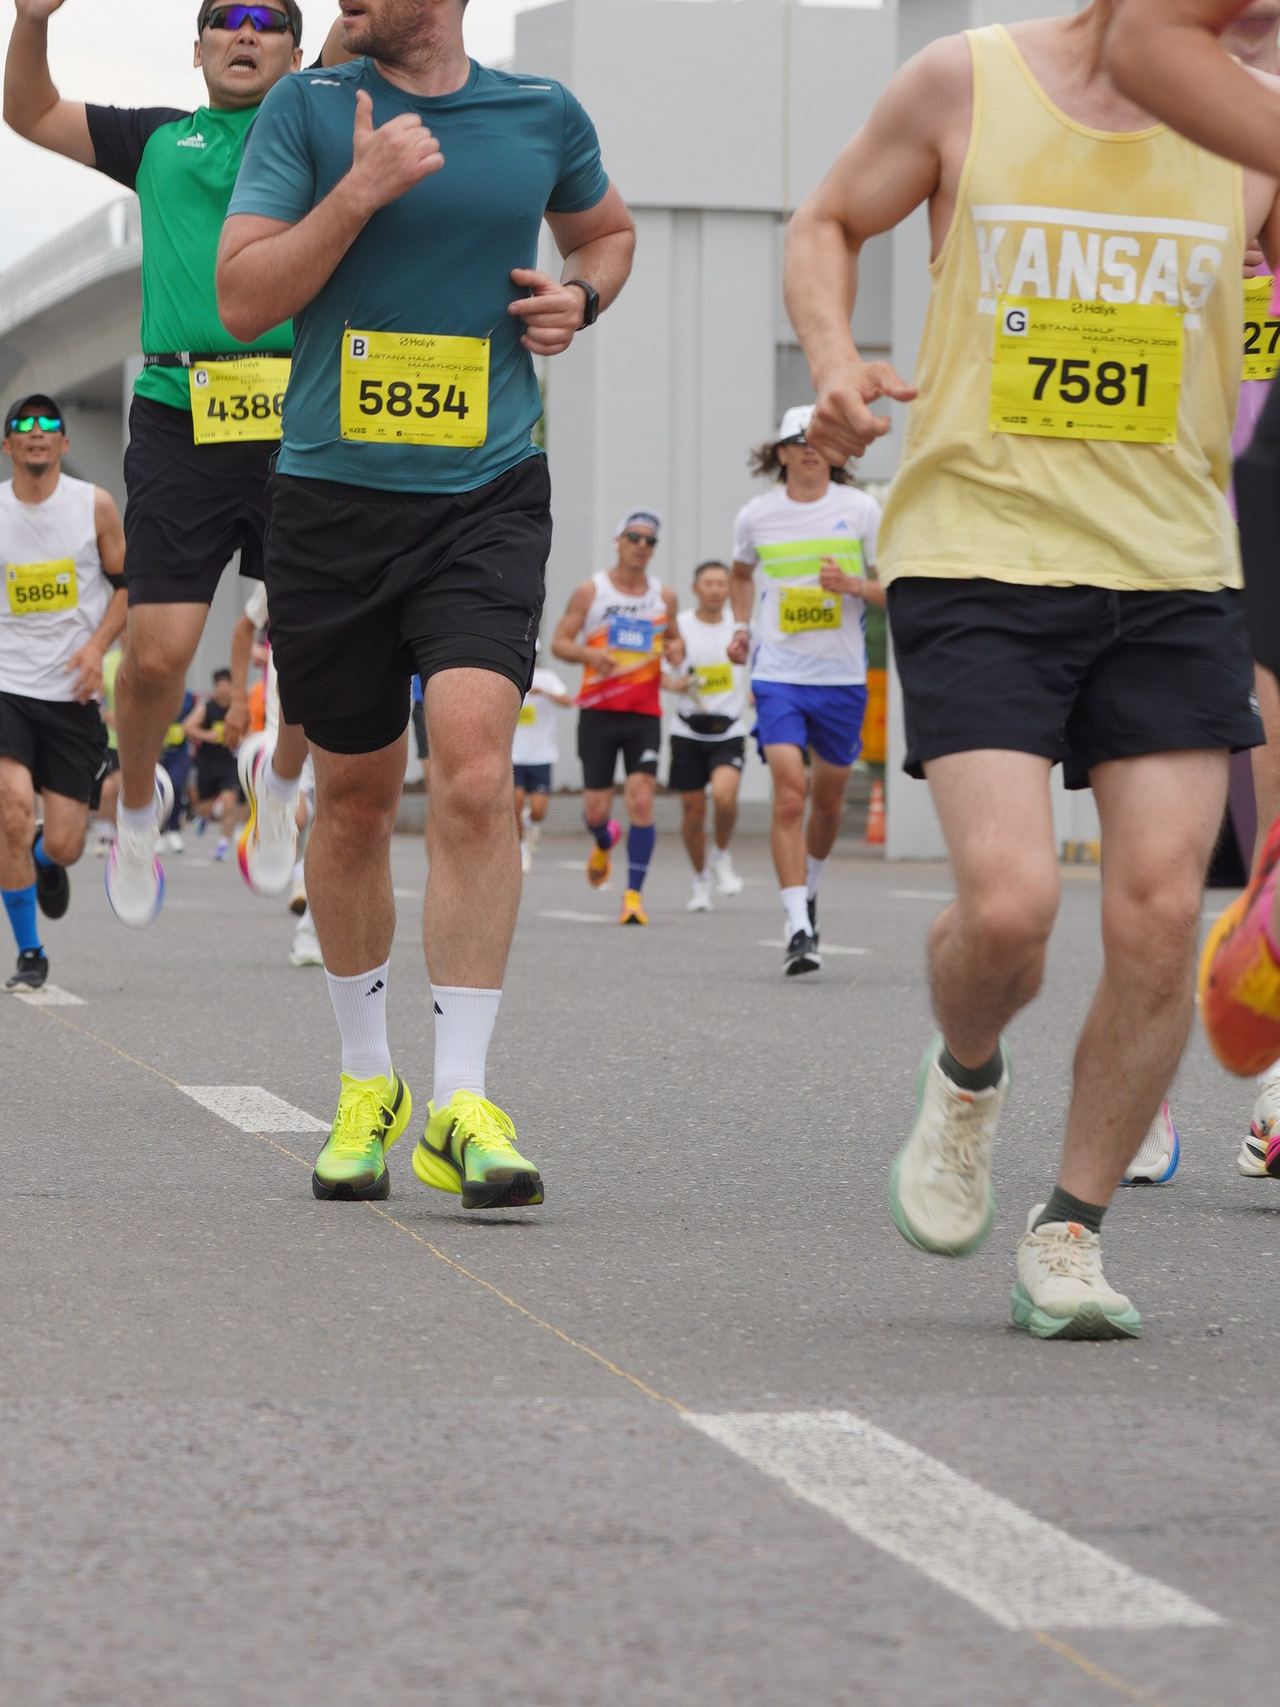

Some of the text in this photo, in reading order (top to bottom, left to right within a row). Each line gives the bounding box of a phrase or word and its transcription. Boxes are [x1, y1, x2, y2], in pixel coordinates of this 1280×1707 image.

[975, 225, 1222, 310] KANSAS
[1084, 304, 1117, 317] Halyk
[1006, 310, 1026, 333] G
[1031, 323, 1080, 332] ASTANA
[353, 338, 365, 357] B
[409, 337, 436, 349] Halyk
[1081, 335, 1149, 345] MARATHON
[196, 371, 207, 385] C
[1028, 356, 1148, 407] 7581
[359, 379, 469, 420] 5834
[15, 583, 69, 604] 5864
